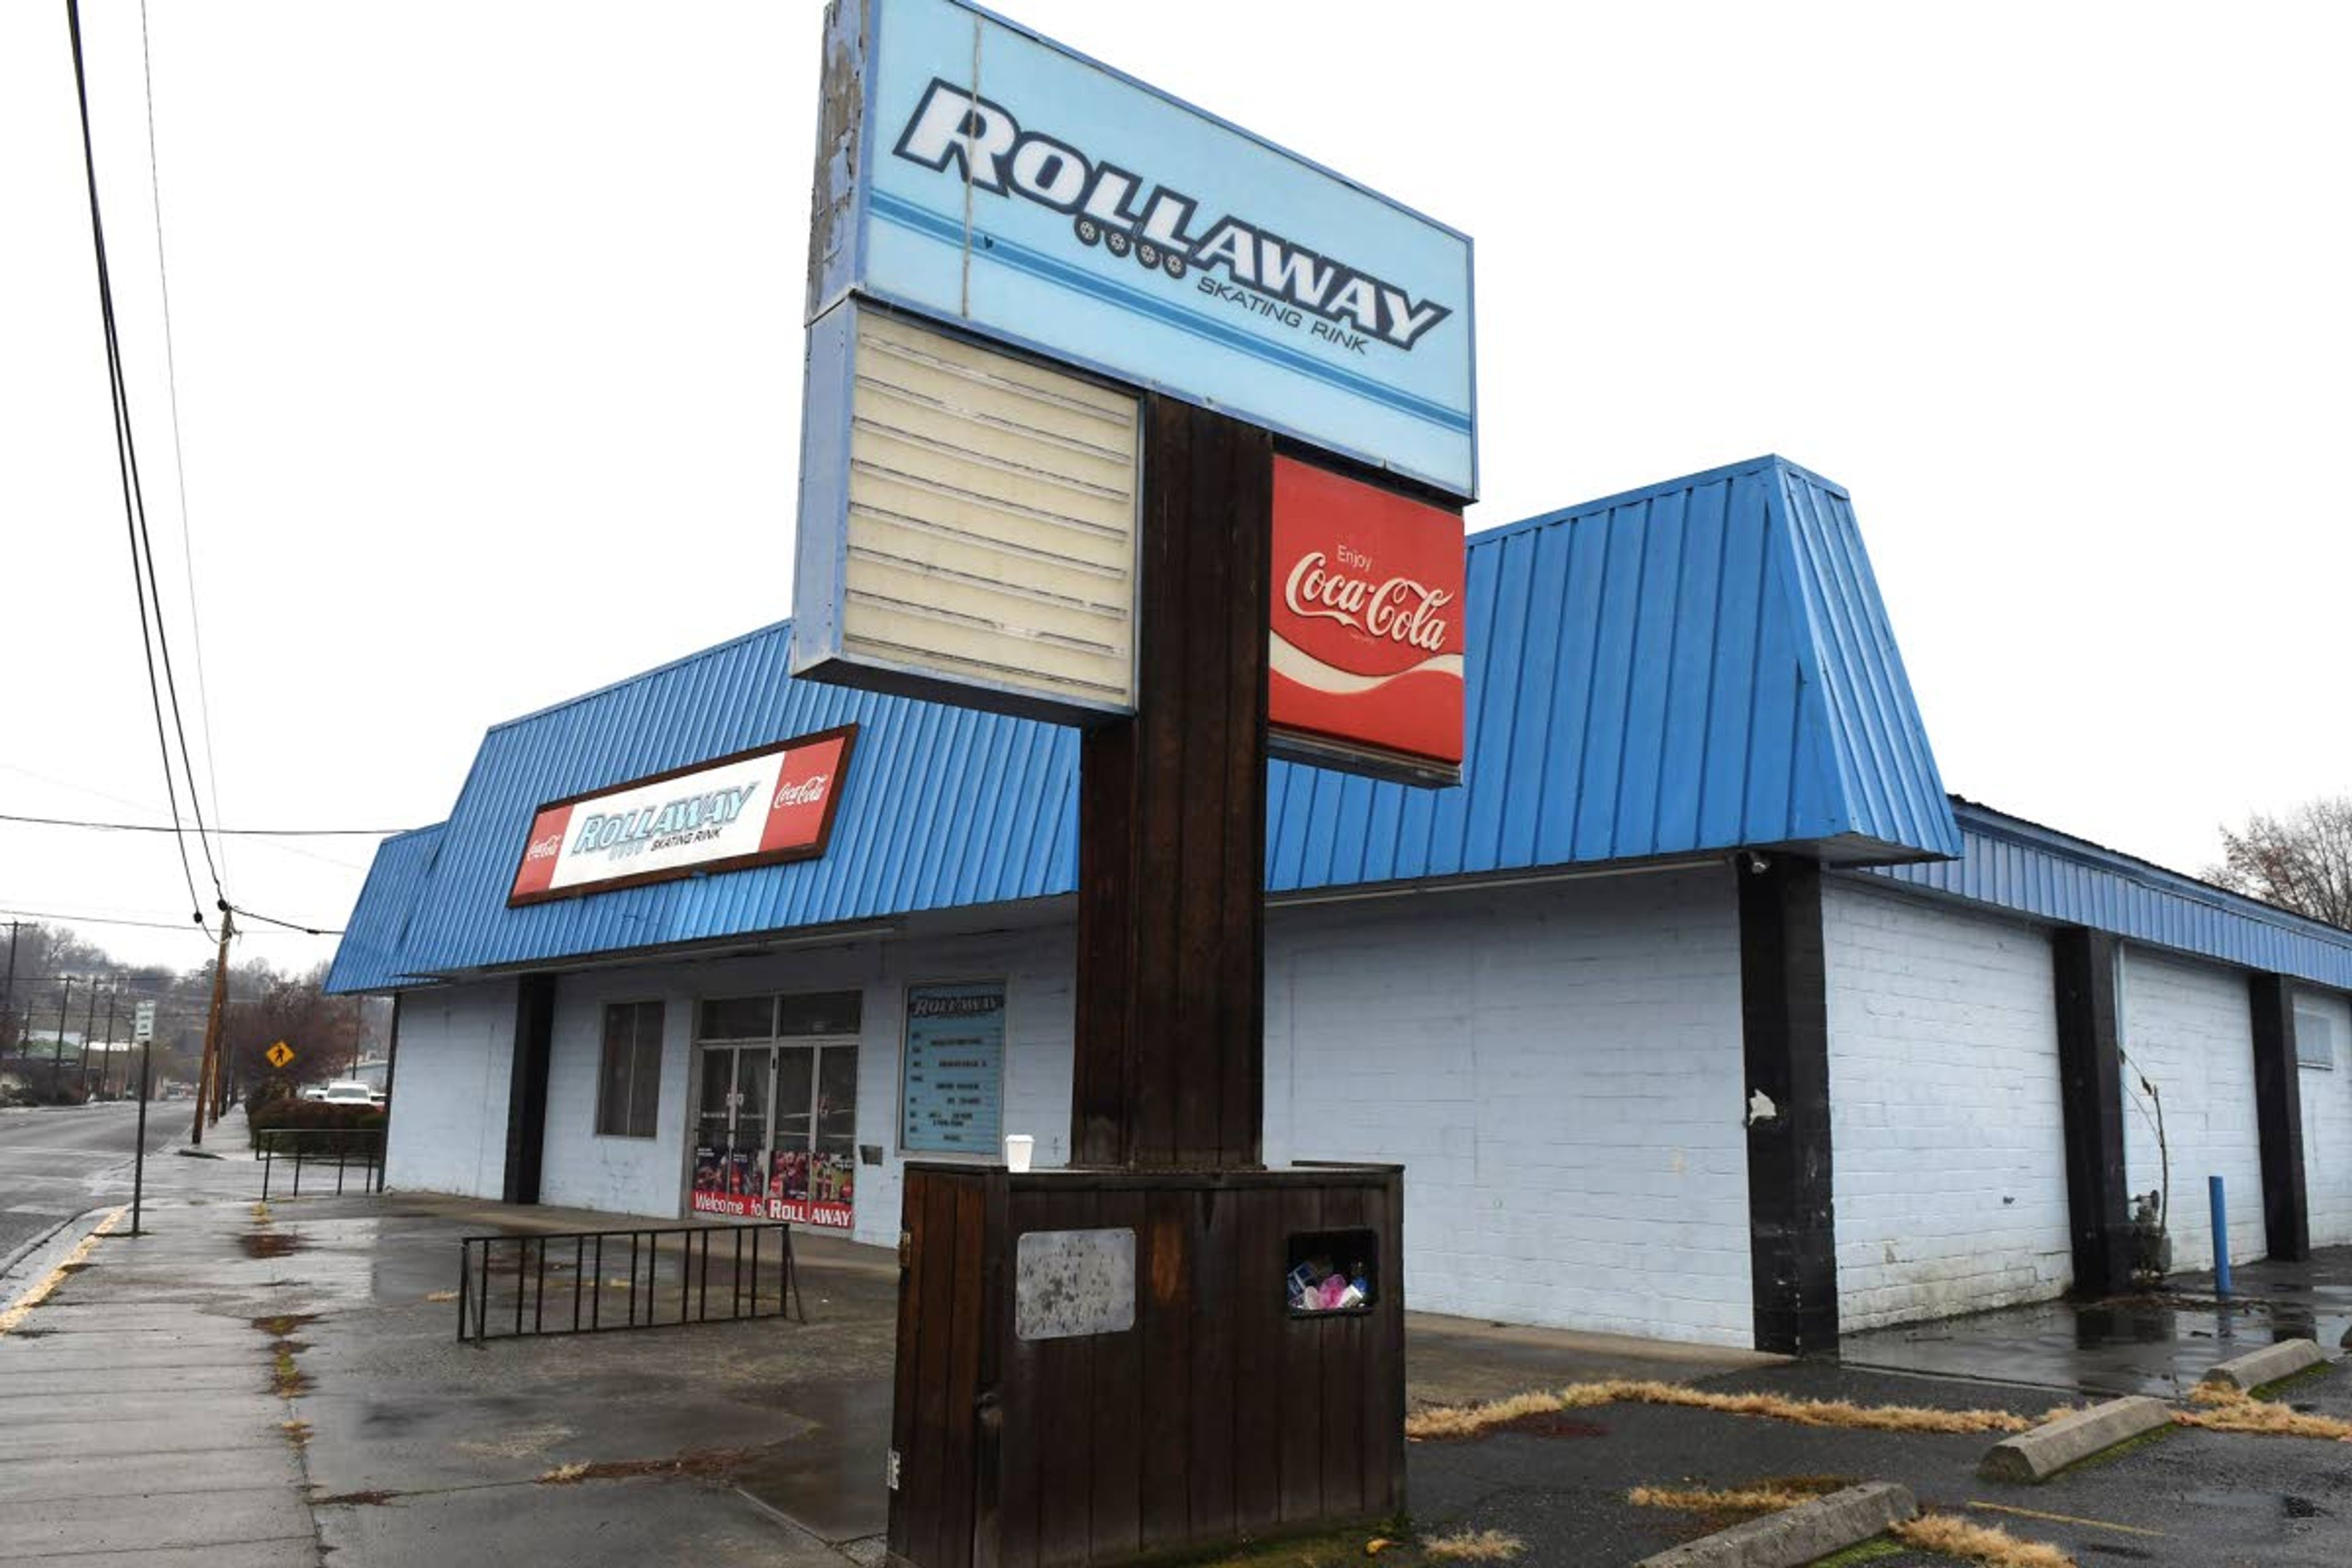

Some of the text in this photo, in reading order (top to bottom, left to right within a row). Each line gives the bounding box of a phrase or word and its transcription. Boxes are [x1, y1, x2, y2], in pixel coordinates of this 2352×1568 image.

[893, 76, 1453, 351] ROLLAWAY
[1197, 276, 1369, 355] SKATING RINK
[1338, 545, 1373, 573] Enjoy
[1286, 551, 1455, 652] Coca-Cola
[571, 780, 762, 856] ROLLAWAY
[774, 774, 829, 809] Coca-Cola
[650, 827, 723, 852] SKATING RINK
[695, 1191, 744, 1215] Welcome
[769, 1199, 807, 1222] ROLL
[811, 1207, 853, 1226] AWAY
